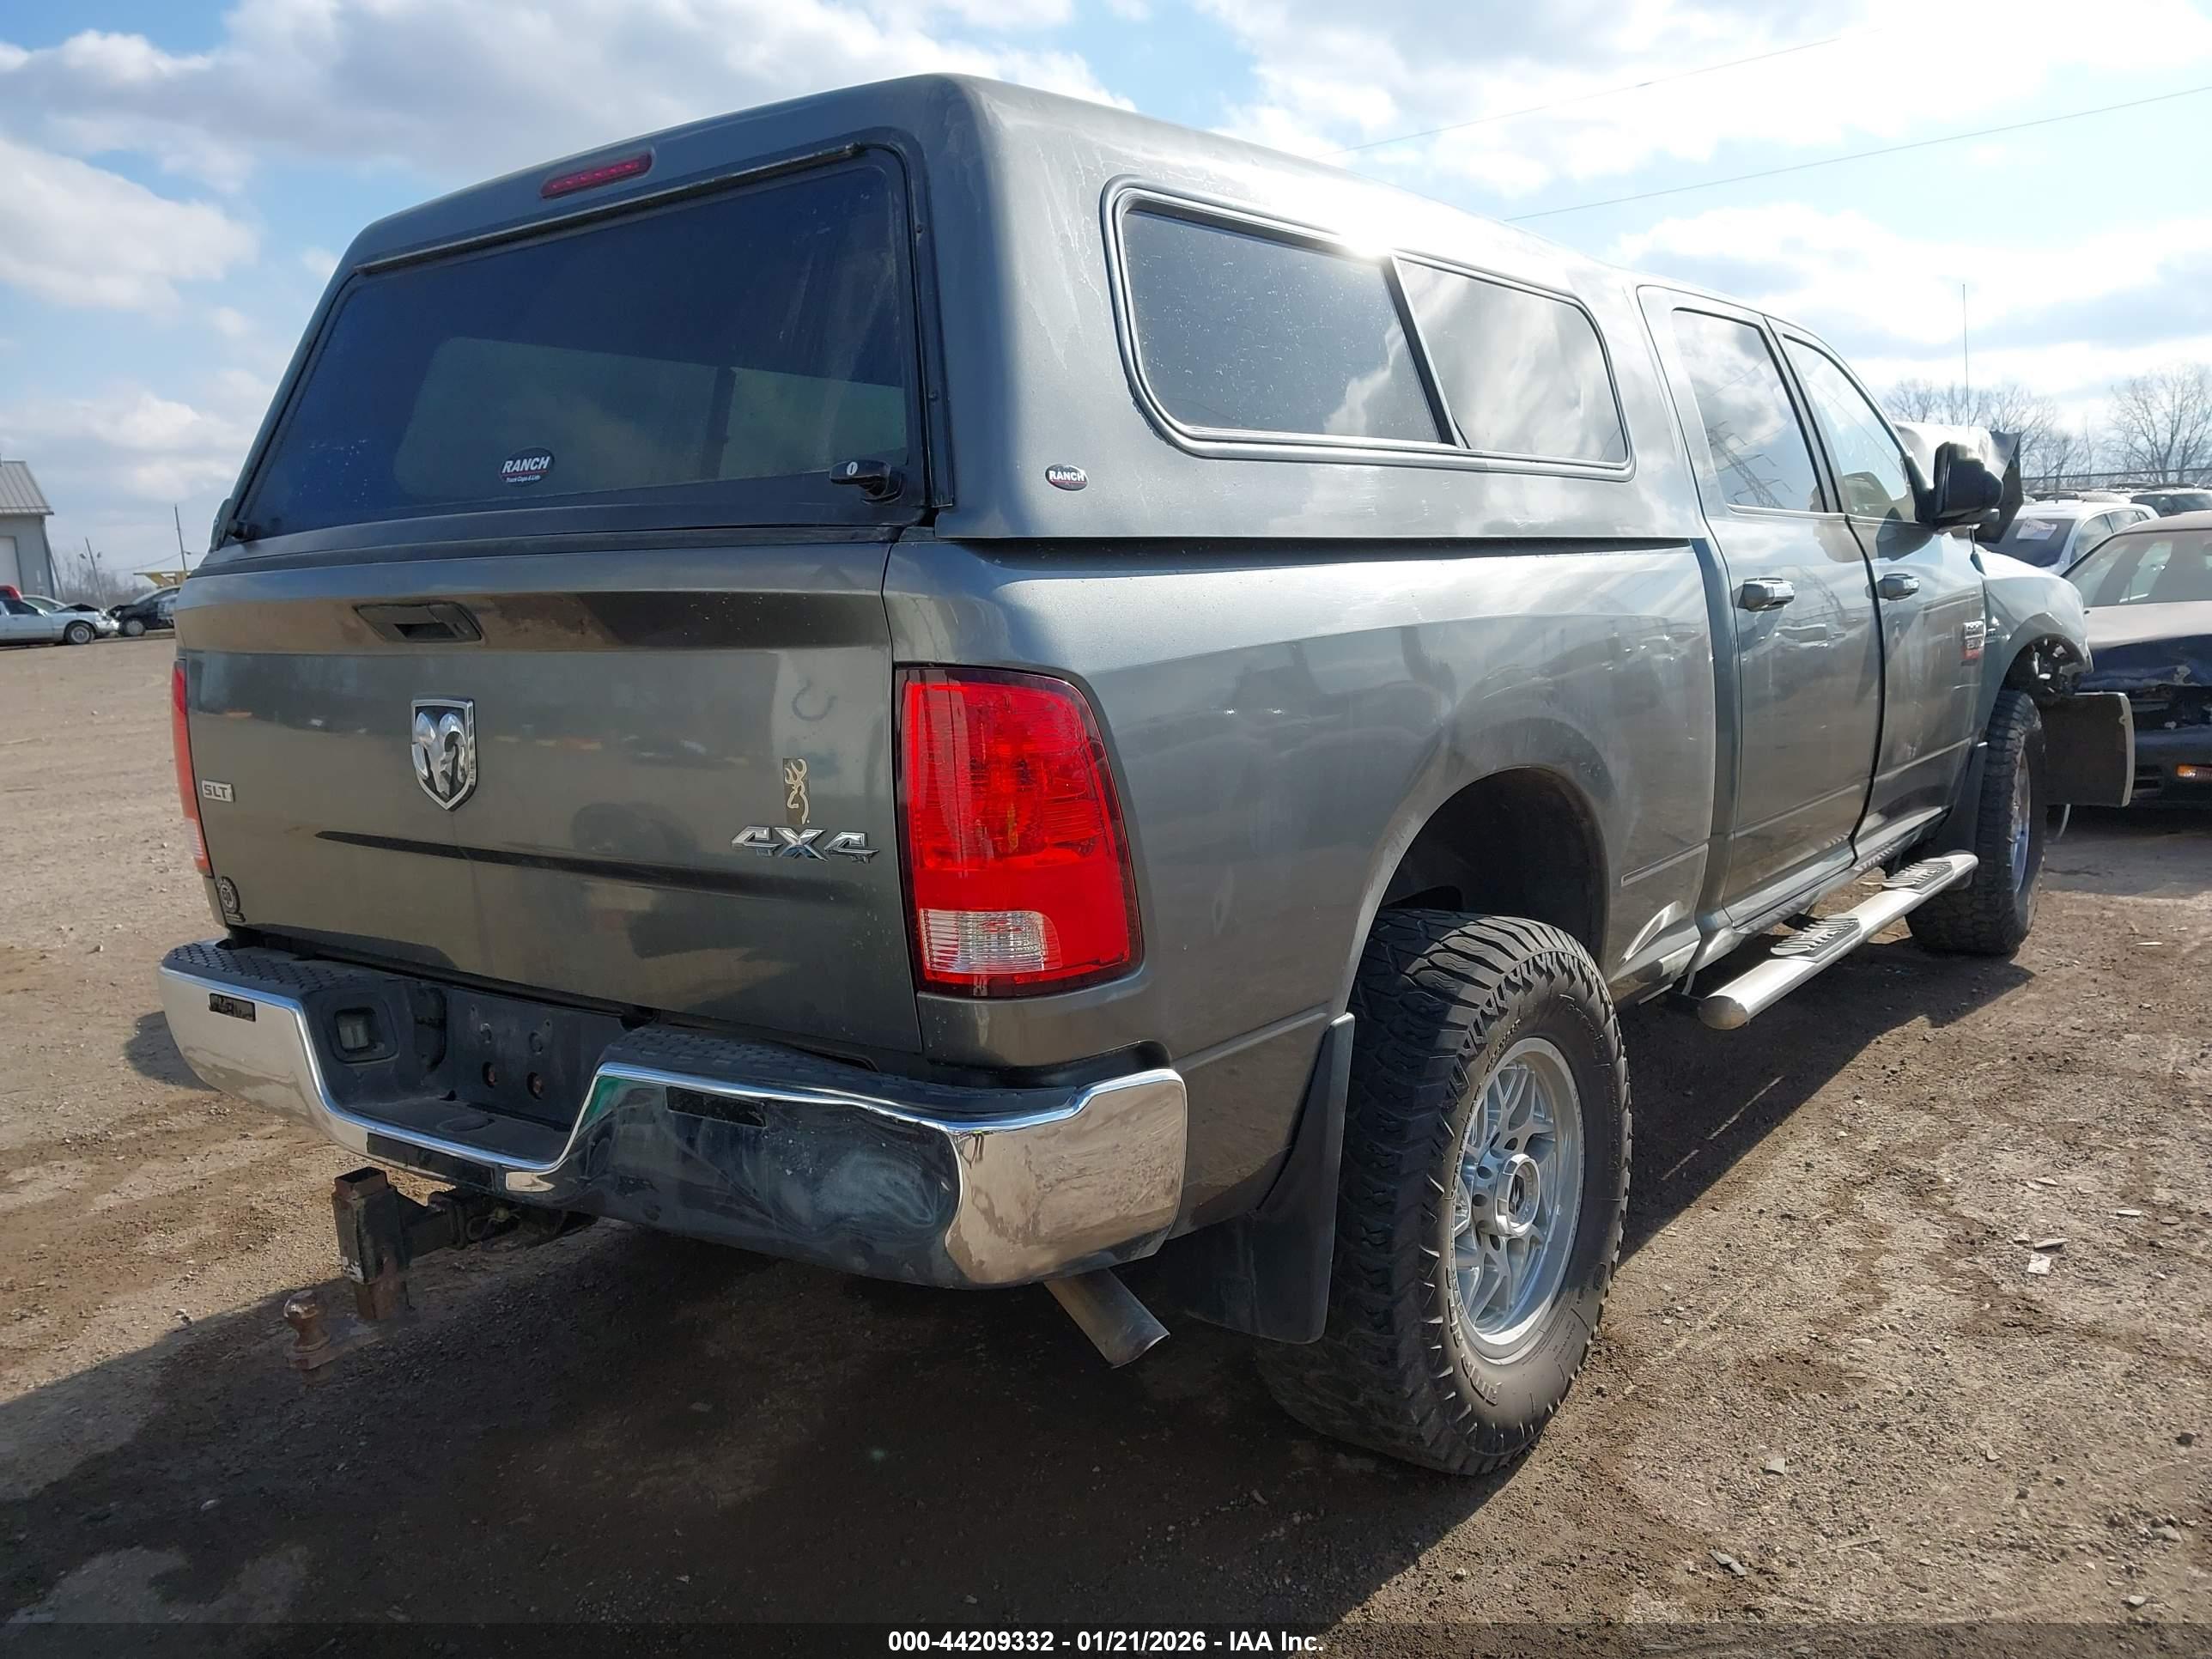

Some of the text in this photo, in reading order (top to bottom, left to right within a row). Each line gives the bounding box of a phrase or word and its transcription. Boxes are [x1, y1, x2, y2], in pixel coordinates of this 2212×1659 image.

[501, 456, 550, 474] RANCH
[1048, 470, 1085, 482] RANCH
[204, 784, 228, 799] SLT
